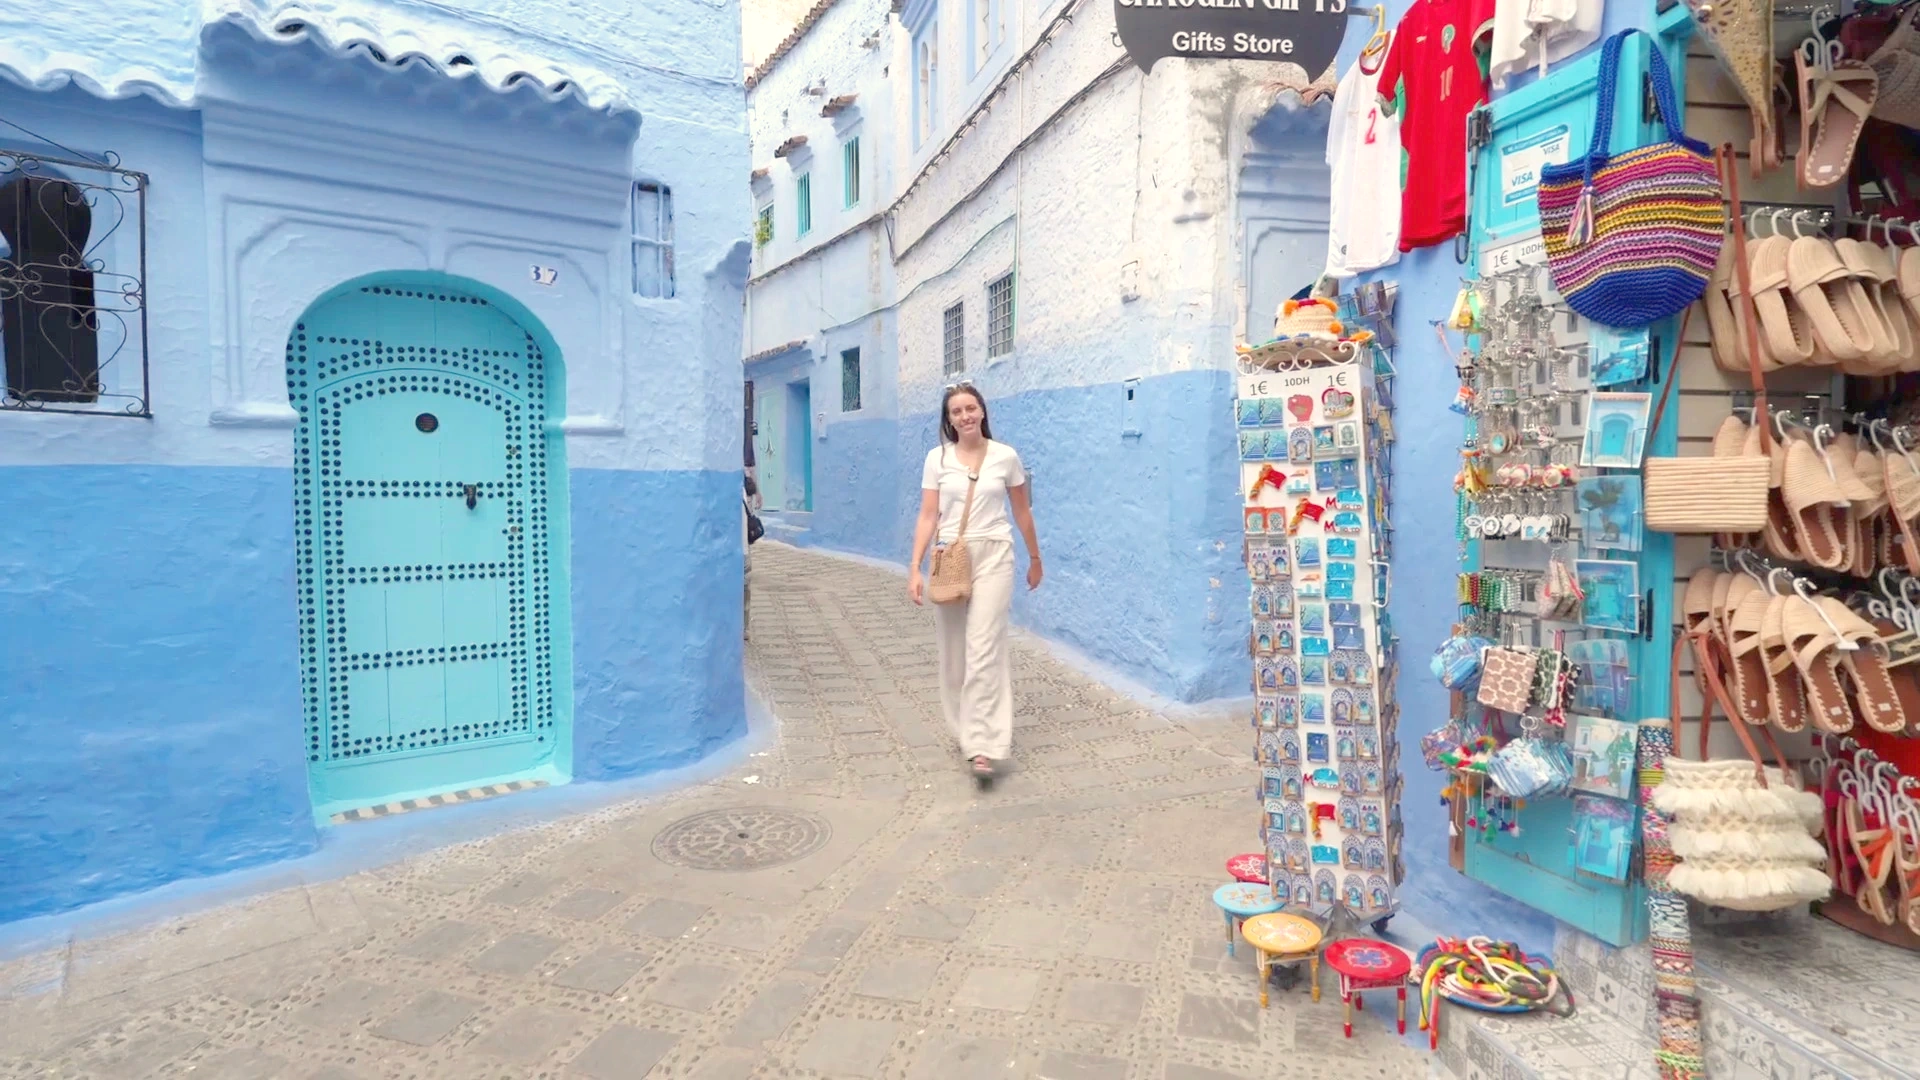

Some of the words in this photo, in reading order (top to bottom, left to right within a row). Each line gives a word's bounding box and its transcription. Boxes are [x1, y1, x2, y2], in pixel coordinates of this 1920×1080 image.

[1172, 31, 1226, 51] Gifts
[1233, 32, 1294, 54] Store
[1364, 107, 1377, 144] 2
[1543, 144, 1560, 155] VISA
[1511, 171, 1534, 187] VISA
[1494, 249, 1509, 268] 1€
[1521, 242, 1544, 256] 10DH
[531, 265, 558, 284] 37
[1250, 380, 1268, 396] 1€
[1284, 376, 1310, 387] 10DH
[1327, 371, 1347, 387] 1€
